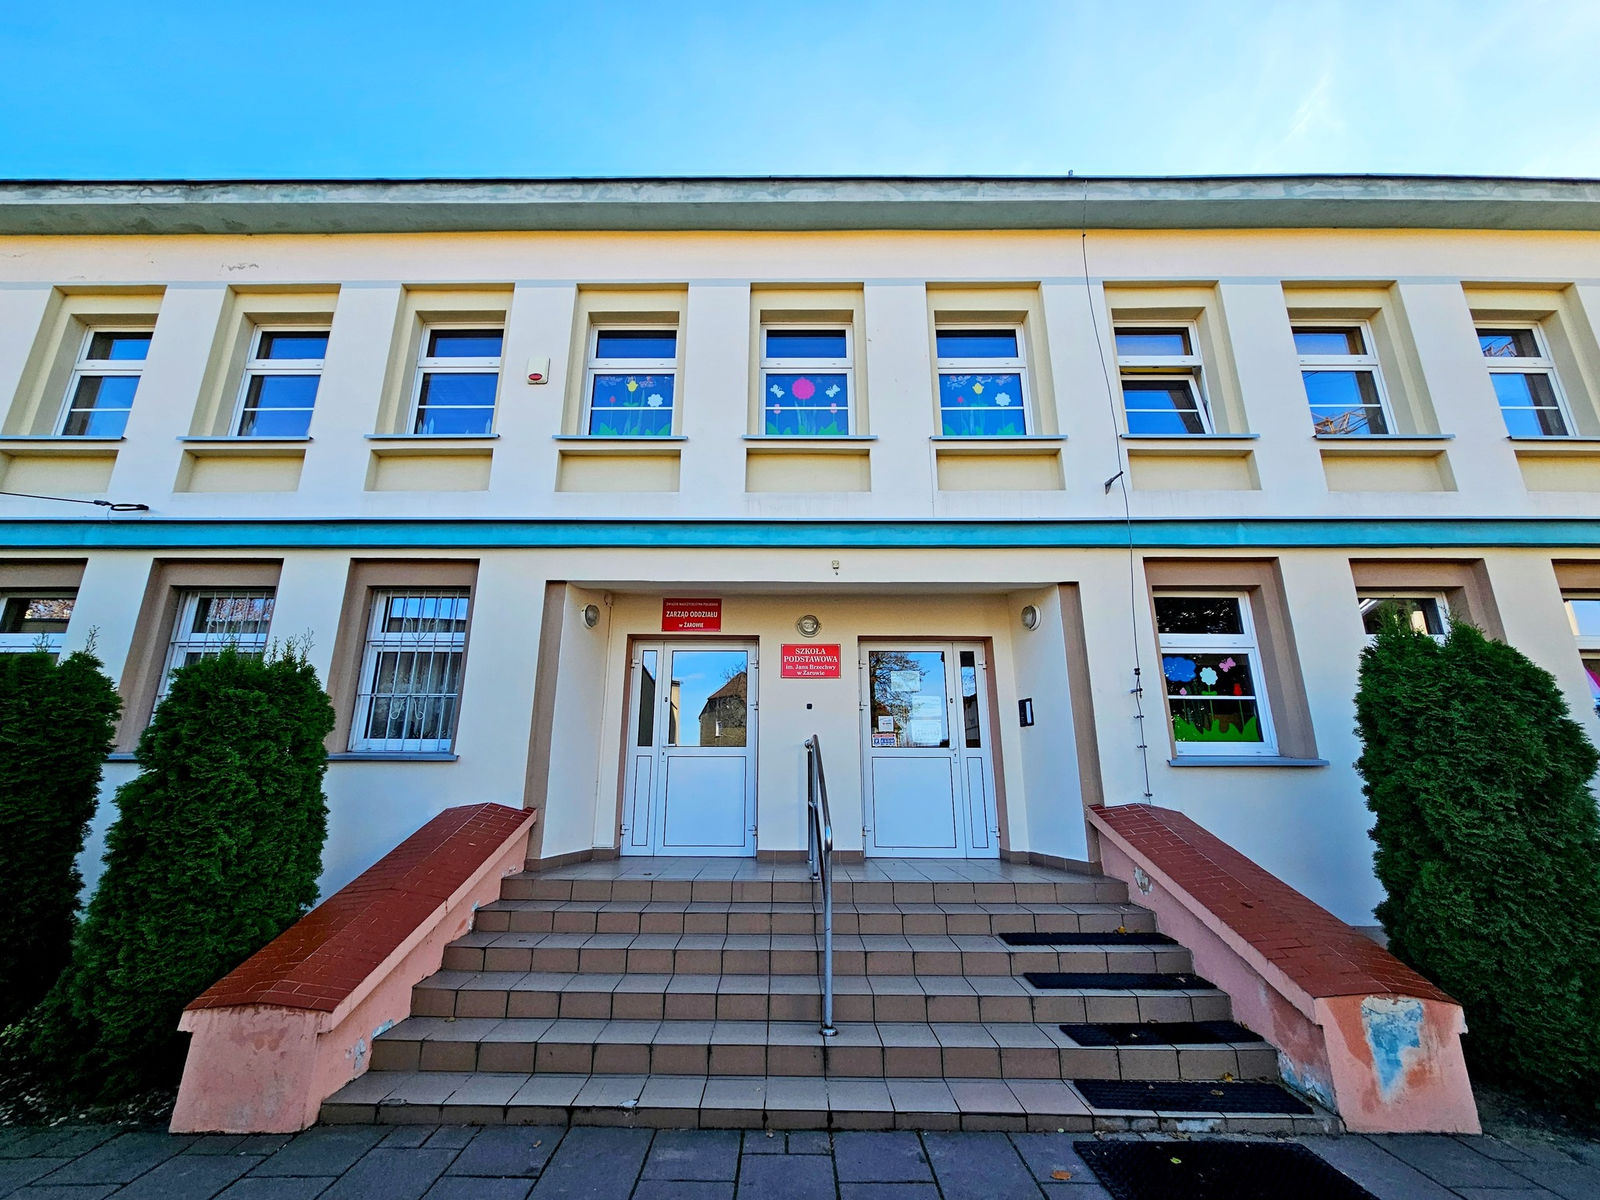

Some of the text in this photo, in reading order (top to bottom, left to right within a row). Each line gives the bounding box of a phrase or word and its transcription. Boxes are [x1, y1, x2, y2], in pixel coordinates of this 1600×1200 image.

[666, 611, 689, 619] ZARZĄD
[795, 647, 826, 655] SZKOŁA
[784, 655, 838, 663] PODSTAWOWA
